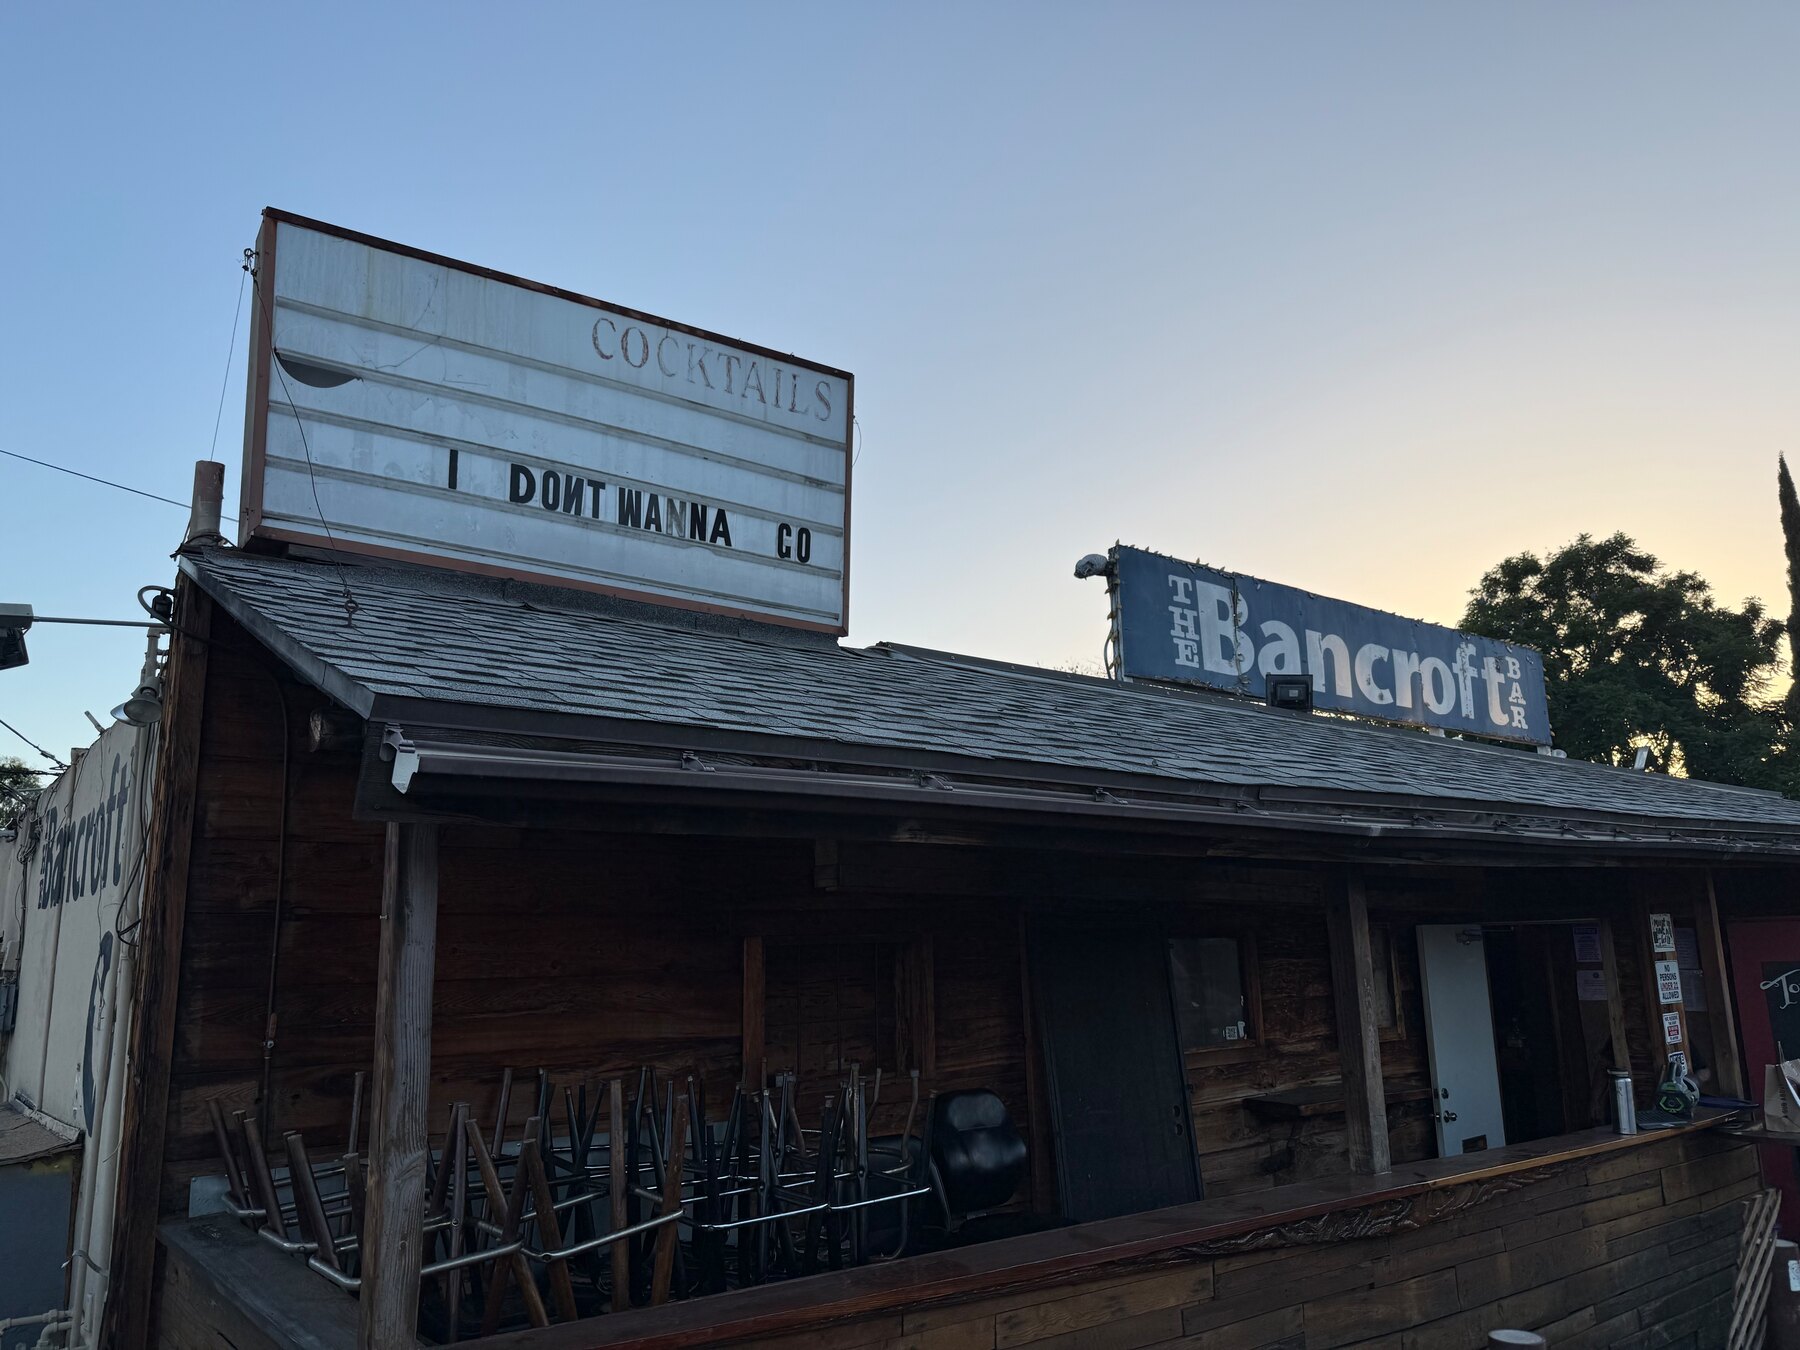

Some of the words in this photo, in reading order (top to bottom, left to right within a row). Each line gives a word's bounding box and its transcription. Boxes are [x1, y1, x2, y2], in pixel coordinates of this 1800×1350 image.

[592, 317, 832, 421] COCKTAILS
[448, 449, 458, 489] I
[509, 463, 606, 519] DONT
[618, 487, 732, 547] WANNA
[1168, 574, 1200, 668] THE
[1196, 579, 1511, 727] Bancroft
[1506, 655, 1529, 731] BAR
[42, 752, 131, 910] Bancroft
[1659, 972, 1677, 982] PERSONS
[1759, 968, 1800, 1009] To
